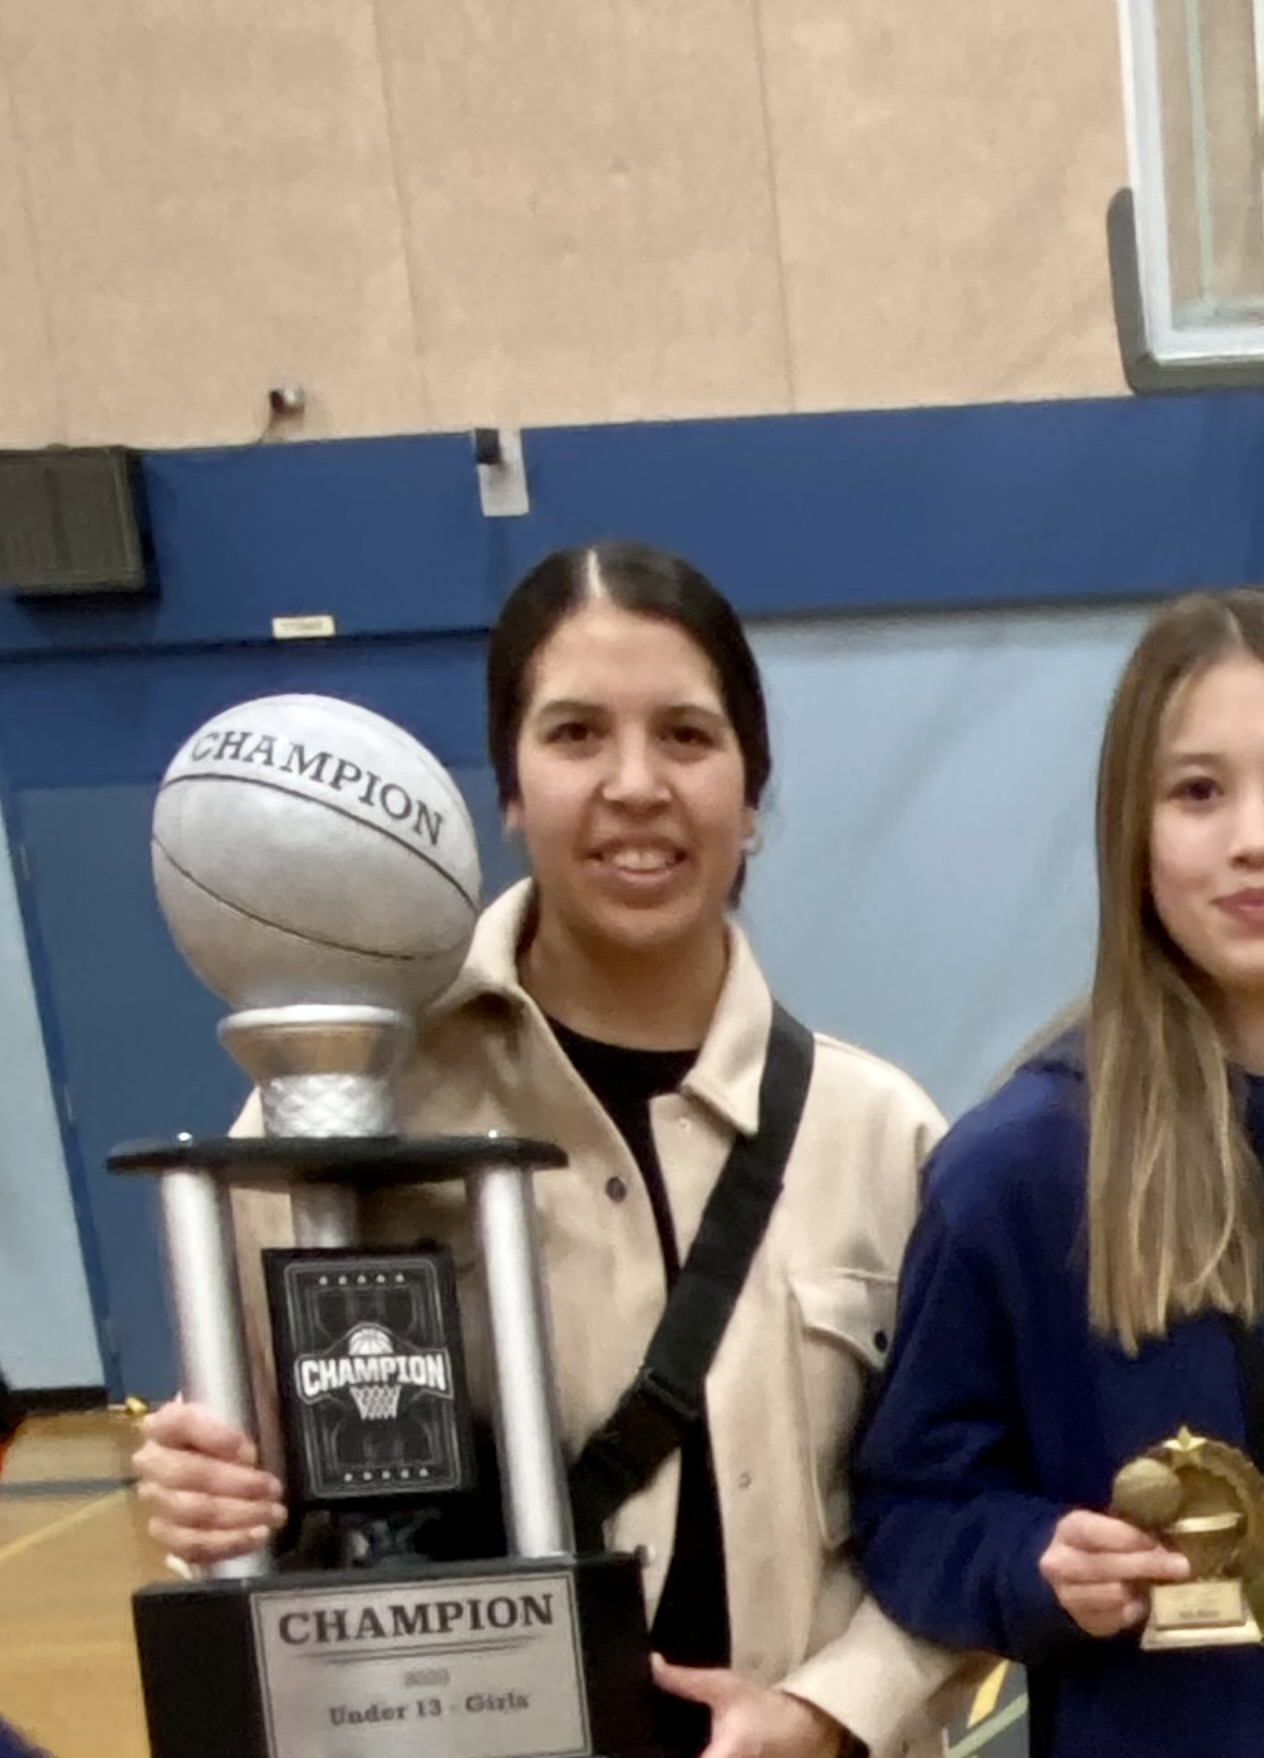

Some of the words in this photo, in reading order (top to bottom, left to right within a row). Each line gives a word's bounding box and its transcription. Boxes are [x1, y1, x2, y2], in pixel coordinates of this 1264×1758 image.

[191, 730, 444, 846] CHAMPION
[301, 1354, 446, 1397] CHAMPION
[278, 1593, 554, 1646] CHAMPION
[330, 1705, 406, 1726] Under
[416, 1698, 442, 1718] 13
[465, 1691, 529, 1713] Girls
